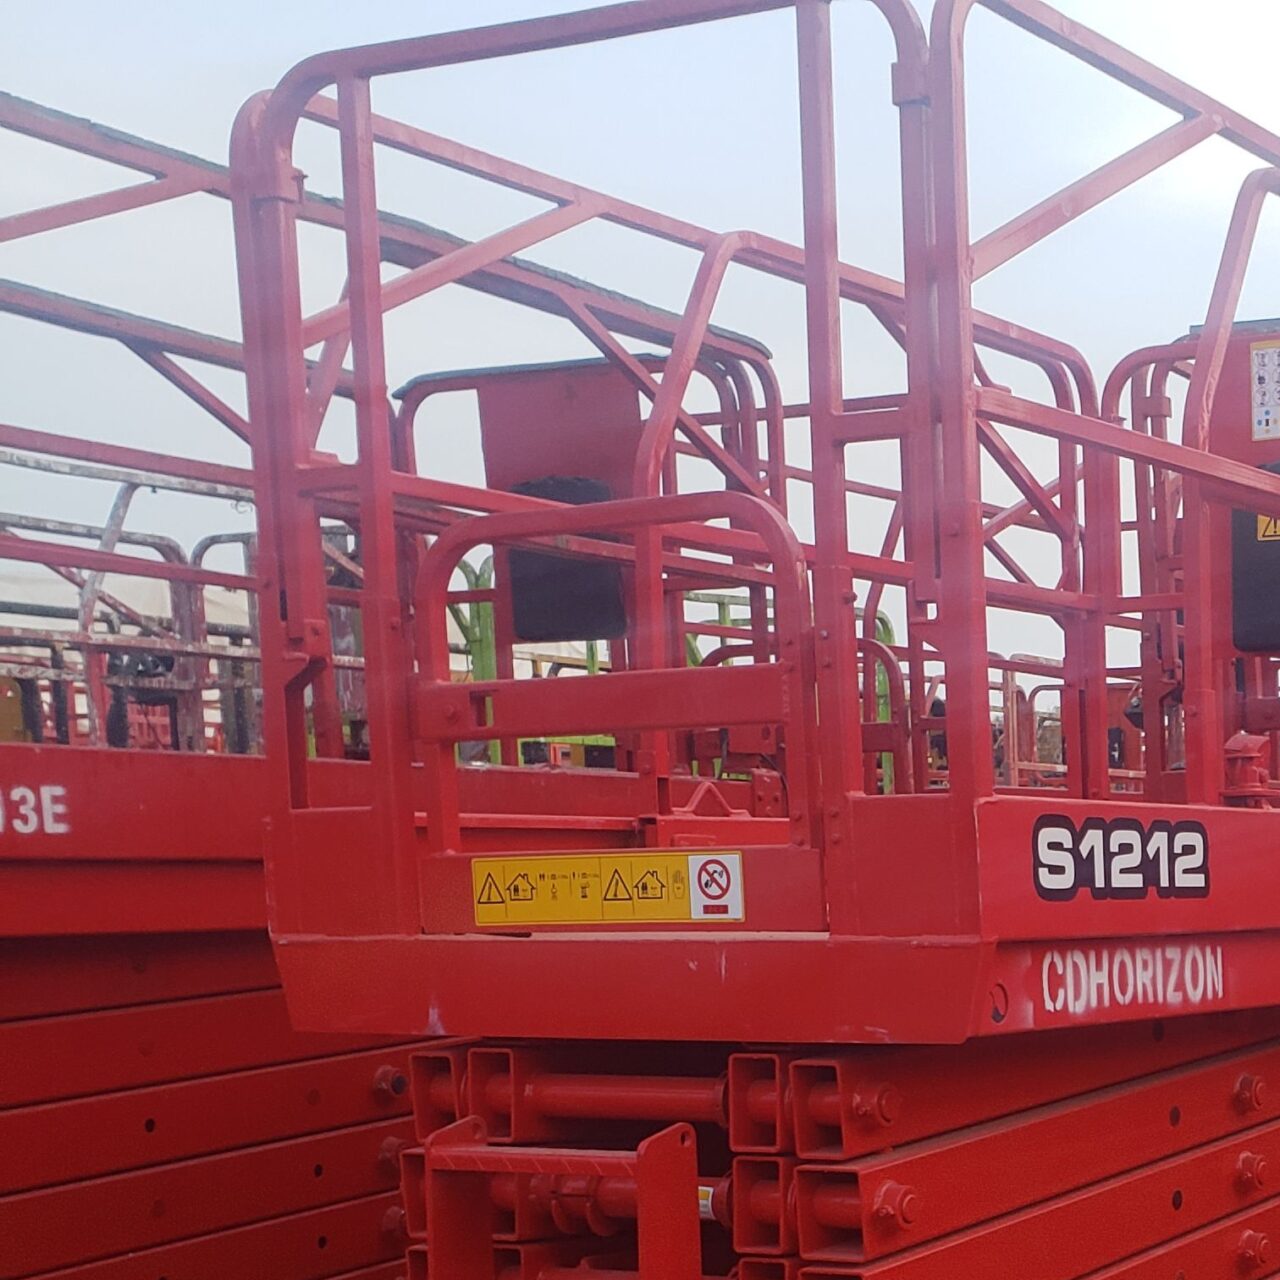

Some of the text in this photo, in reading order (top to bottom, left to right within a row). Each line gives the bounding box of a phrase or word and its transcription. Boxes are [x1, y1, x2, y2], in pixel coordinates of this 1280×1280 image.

[0, 785, 70, 835] 3E
[1037, 826, 1206, 890] S1212
[1042, 946, 1224, 1014] CDHORIZON
